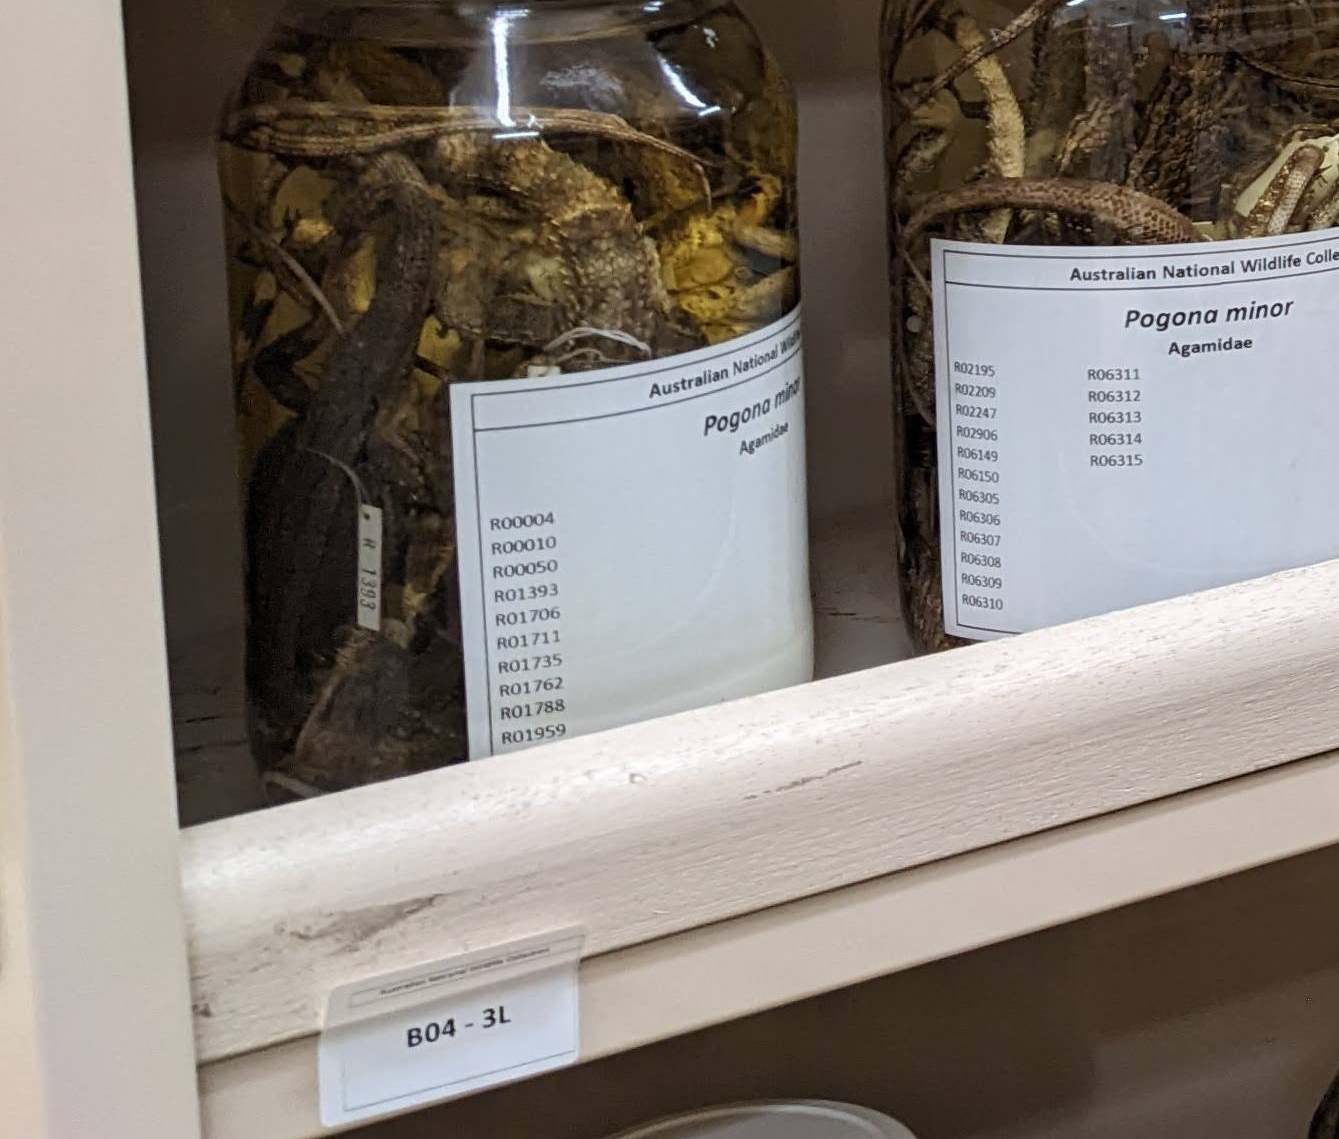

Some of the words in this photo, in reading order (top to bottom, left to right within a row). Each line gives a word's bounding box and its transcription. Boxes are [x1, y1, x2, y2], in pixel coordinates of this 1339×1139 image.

[1070, 267, 1156, 282] Australian
[1163, 261, 1235, 278] National
[1241, 256, 1300, 275] Wildlife
[1125, 309, 1217, 331] Pogona
[1226, 298, 1294, 323] minor
[1168, 337, 1253, 358] Agamidae
[649, 365, 729, 398] Australian
[733, 343, 779, 375] National
[954, 362, 995, 377] R02195
[1088, 369, 1140, 381] R06311
[955, 384, 996, 398] R02209
[1088, 390, 1141, 402] R06312
[703, 398, 771, 436] Pogona
[956, 404, 997, 419] R02247
[1089, 411, 1142, 424] R06313
[739, 422, 789, 456] Agamidae
[956, 426, 997, 441] R02906
[1090, 433, 1142, 445] R06314
[957, 447, 998, 462] R06149
[1090, 454, 1143, 466] R06315
[958, 468, 999, 483] R06150
[959, 490, 999, 505] R06305
[491, 512, 554, 530] R00004
[959, 511, 1000, 526] R06306
[492, 536, 556, 556] R00010
[960, 532, 1000, 546] R06307
[961, 553, 1001, 568] R06308
[493, 560, 558, 578] R00050
[962, 574, 1002, 589] R06309
[494, 584, 559, 603] R01393
[962, 595, 1003, 610] R06310
[495, 607, 561, 626] R01706
[497, 630, 561, 650] R01711
[498, 653, 563, 673] R01735
[499, 677, 564, 697] R01762
[500, 700, 565, 720] R01788
[501, 724, 566, 745] R01959
[407, 1018, 456, 1047] B04
[482, 1006, 511, 1028] 3L
